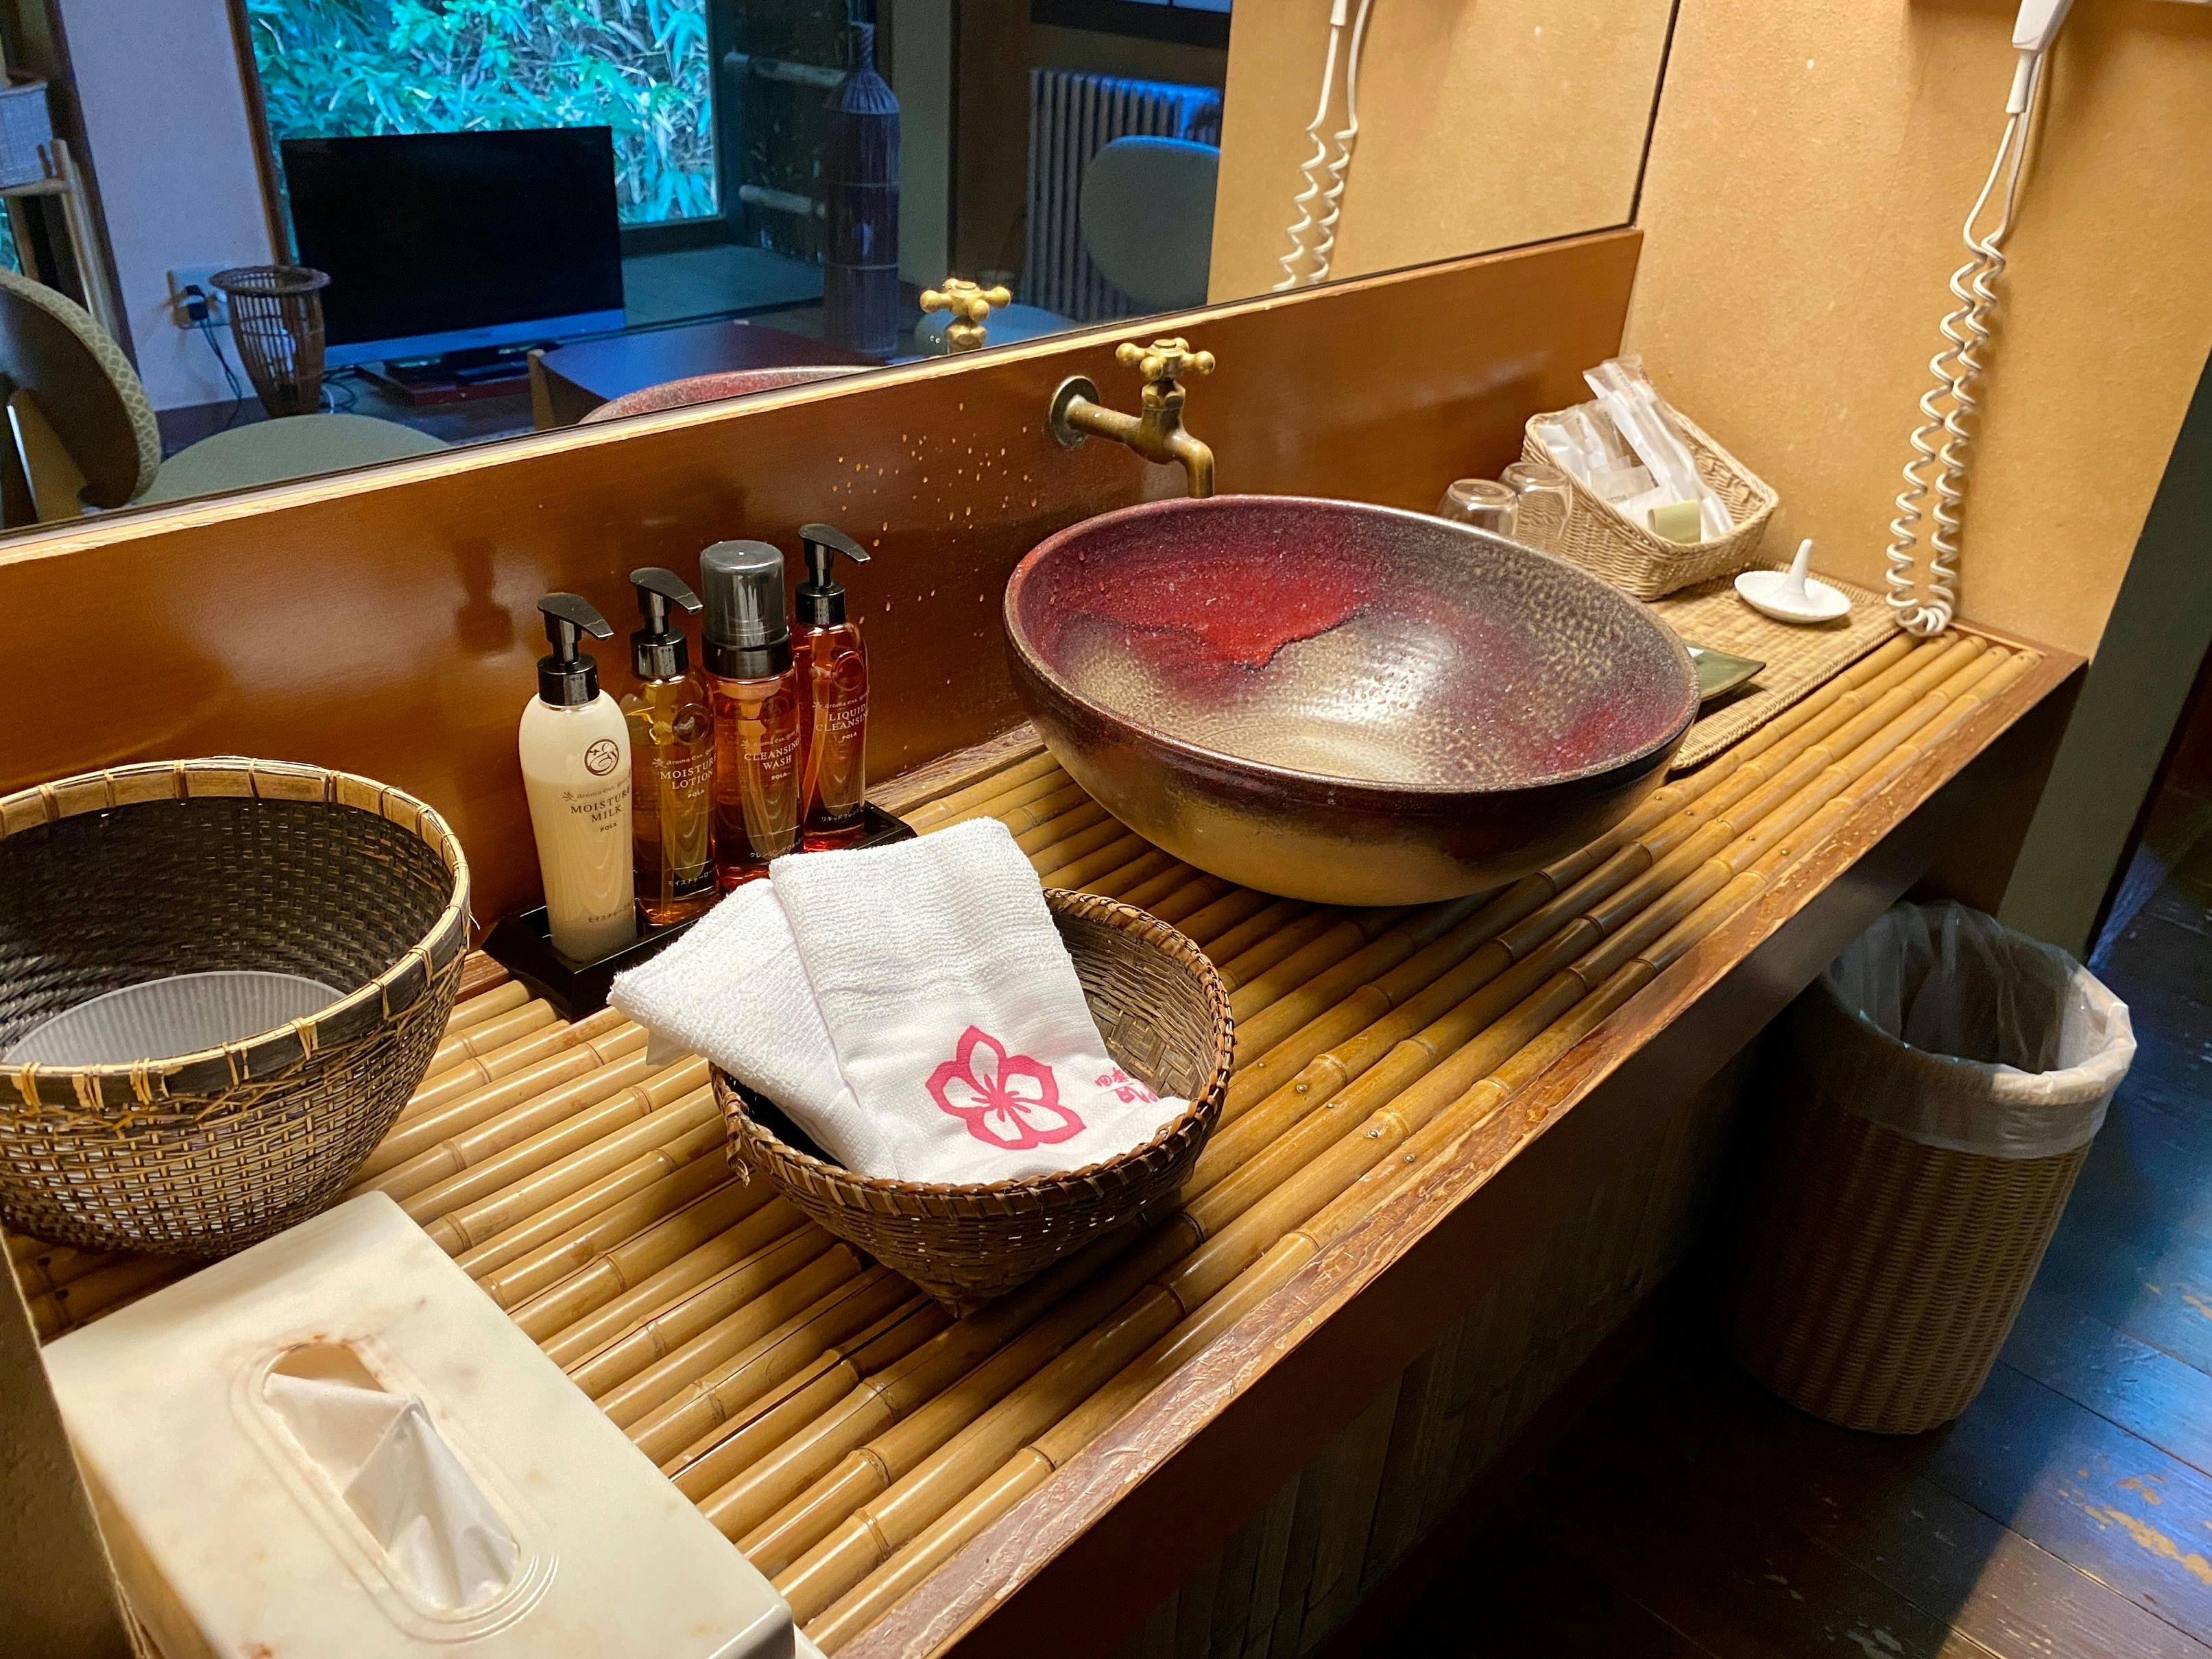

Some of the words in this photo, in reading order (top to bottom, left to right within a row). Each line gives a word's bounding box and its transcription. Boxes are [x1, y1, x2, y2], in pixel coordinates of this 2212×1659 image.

[815, 709, 868, 731] CLEANSIN
[829, 703, 866, 722] LIQUID
[841, 731, 857, 740] POLA
[743, 737, 800, 762] CLEANSING
[762, 754, 792, 770] WASH
[671, 768, 713, 790] LOTION
[771, 772, 787, 781] POLA
[687, 789, 705, 799] POLA
[591, 803, 622, 823] MILK
[600, 822, 617, 833] POLA
